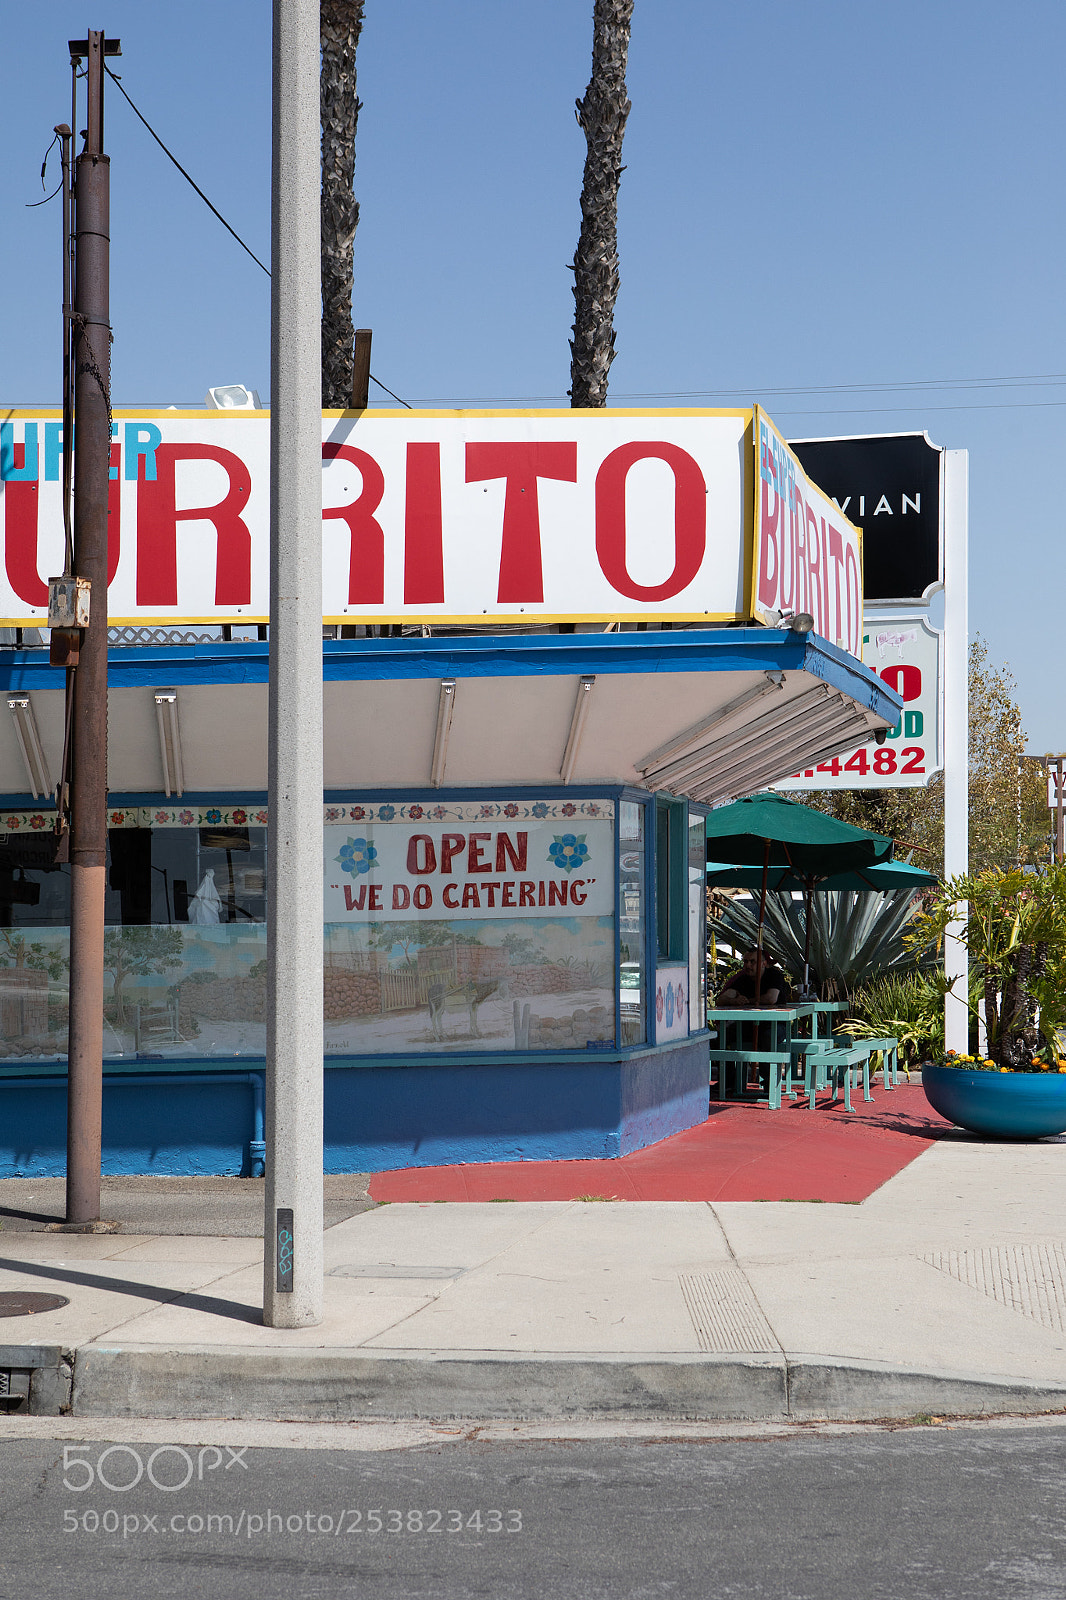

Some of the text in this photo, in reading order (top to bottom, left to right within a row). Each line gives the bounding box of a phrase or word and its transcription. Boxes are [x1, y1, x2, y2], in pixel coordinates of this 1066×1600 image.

[1, 423, 162, 481] UPR
[759, 447, 859, 656] BURRITO
[406, 832, 528, 875] OPEN
[392, 883, 433, 910] DO
